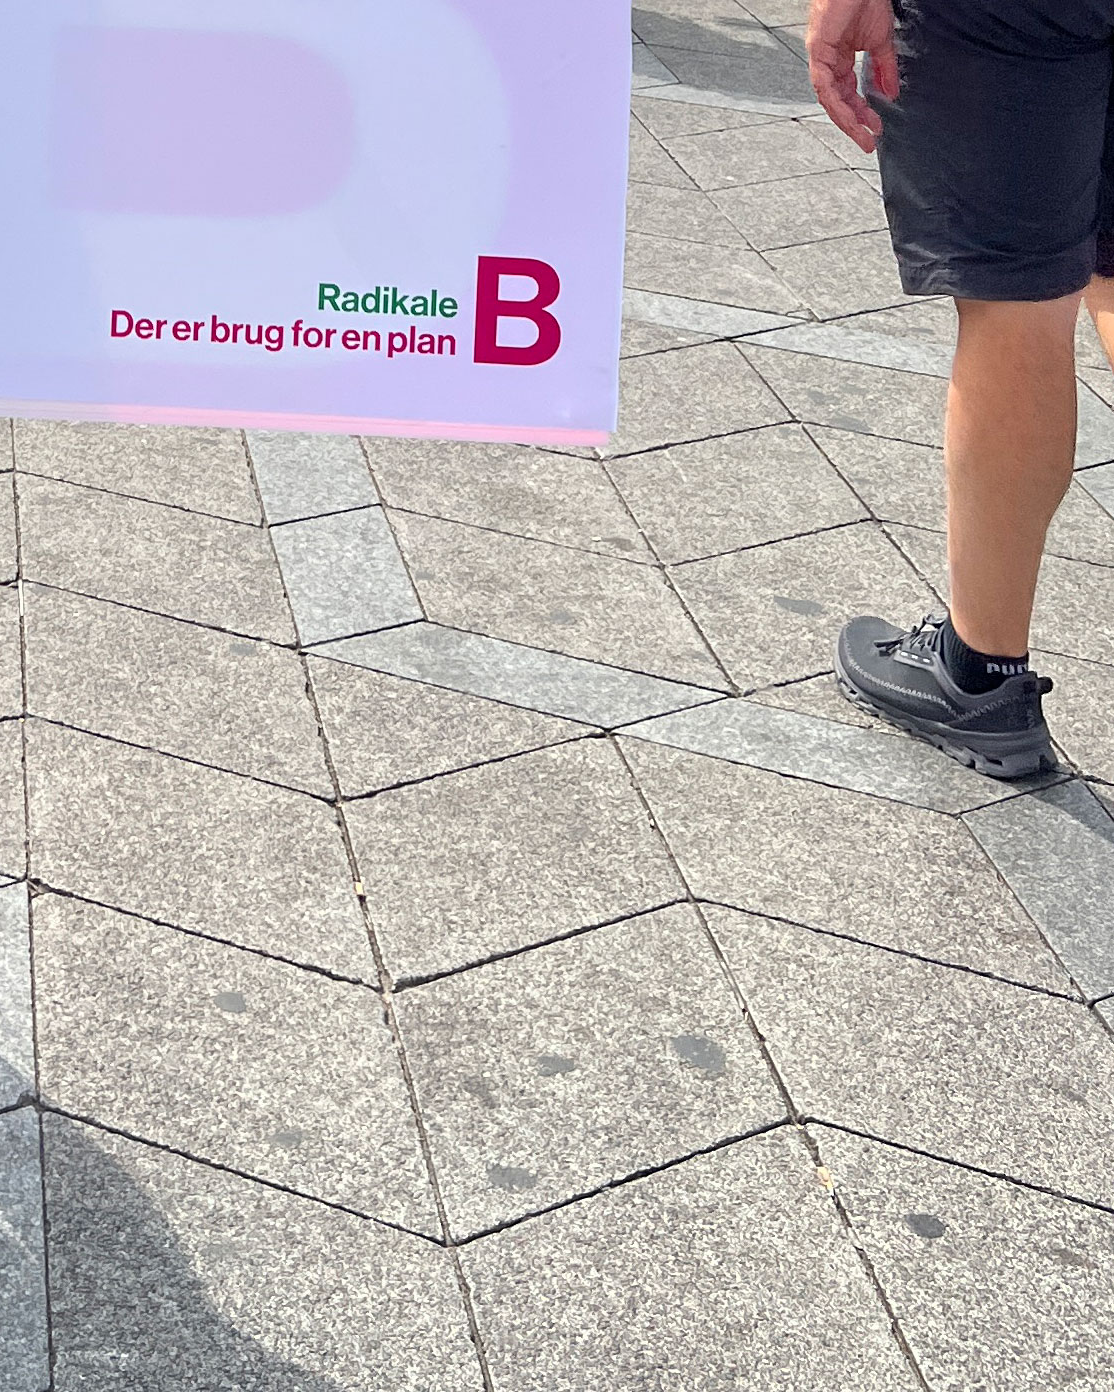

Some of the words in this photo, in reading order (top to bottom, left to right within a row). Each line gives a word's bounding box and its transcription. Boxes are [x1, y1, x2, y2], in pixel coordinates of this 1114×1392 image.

[318, 283, 458, 318] Radikale
[473, 255, 562, 366] B
[111, 310, 168, 340] Der
[172, 320, 205, 342] er
[210, 314, 284, 352] brug
[292, 319, 337, 348] for
[342, 329, 381, 352] en
[387, 325, 457, 358] plan
